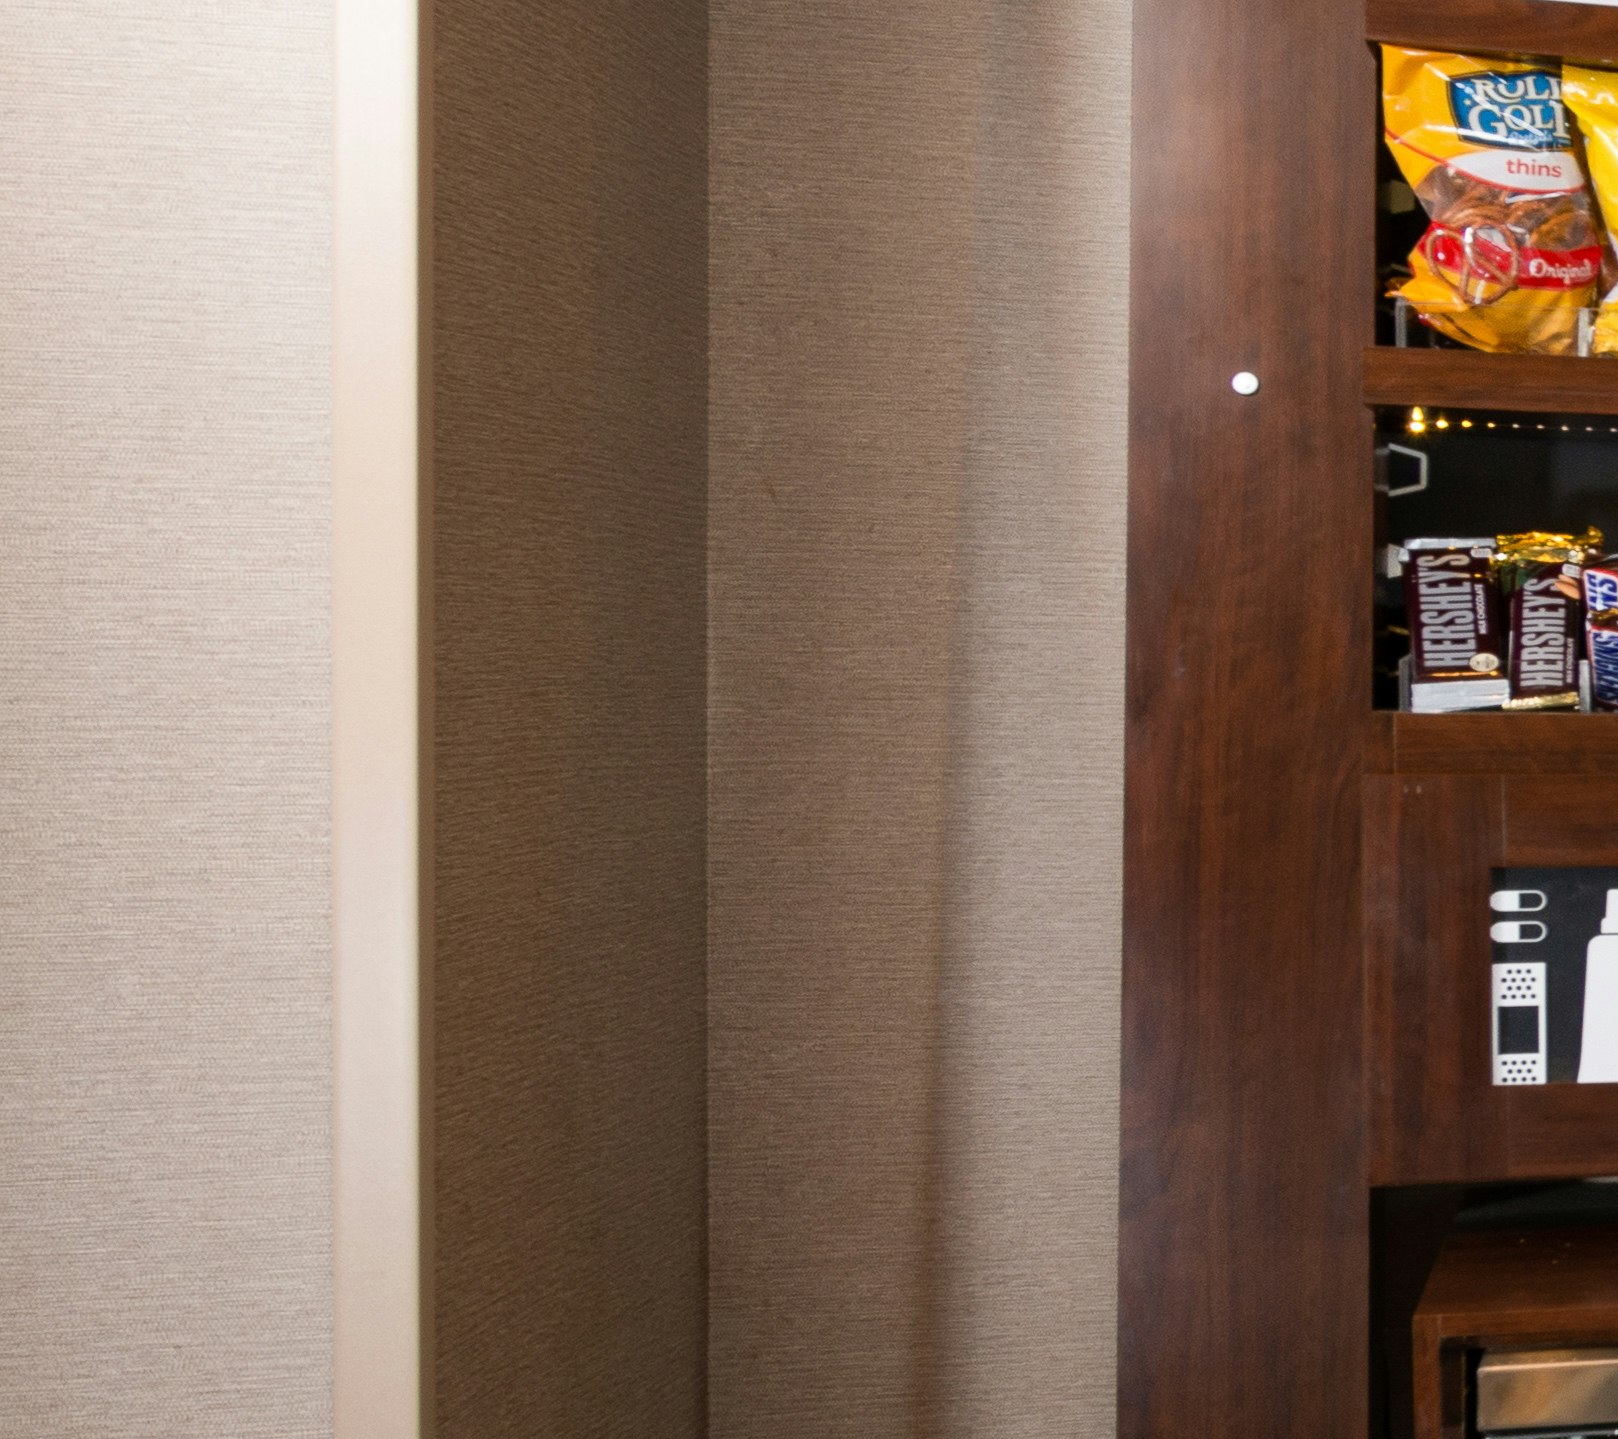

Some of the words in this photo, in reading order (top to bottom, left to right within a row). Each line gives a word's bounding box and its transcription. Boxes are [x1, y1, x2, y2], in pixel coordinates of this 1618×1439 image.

[1505, 158, 1563, 179] thins
[1528, 258, 1592, 284] Original
[1417, 553, 1477, 669] HERSHEY'S
[1519, 577, 1567, 688] HERSHEY'S
